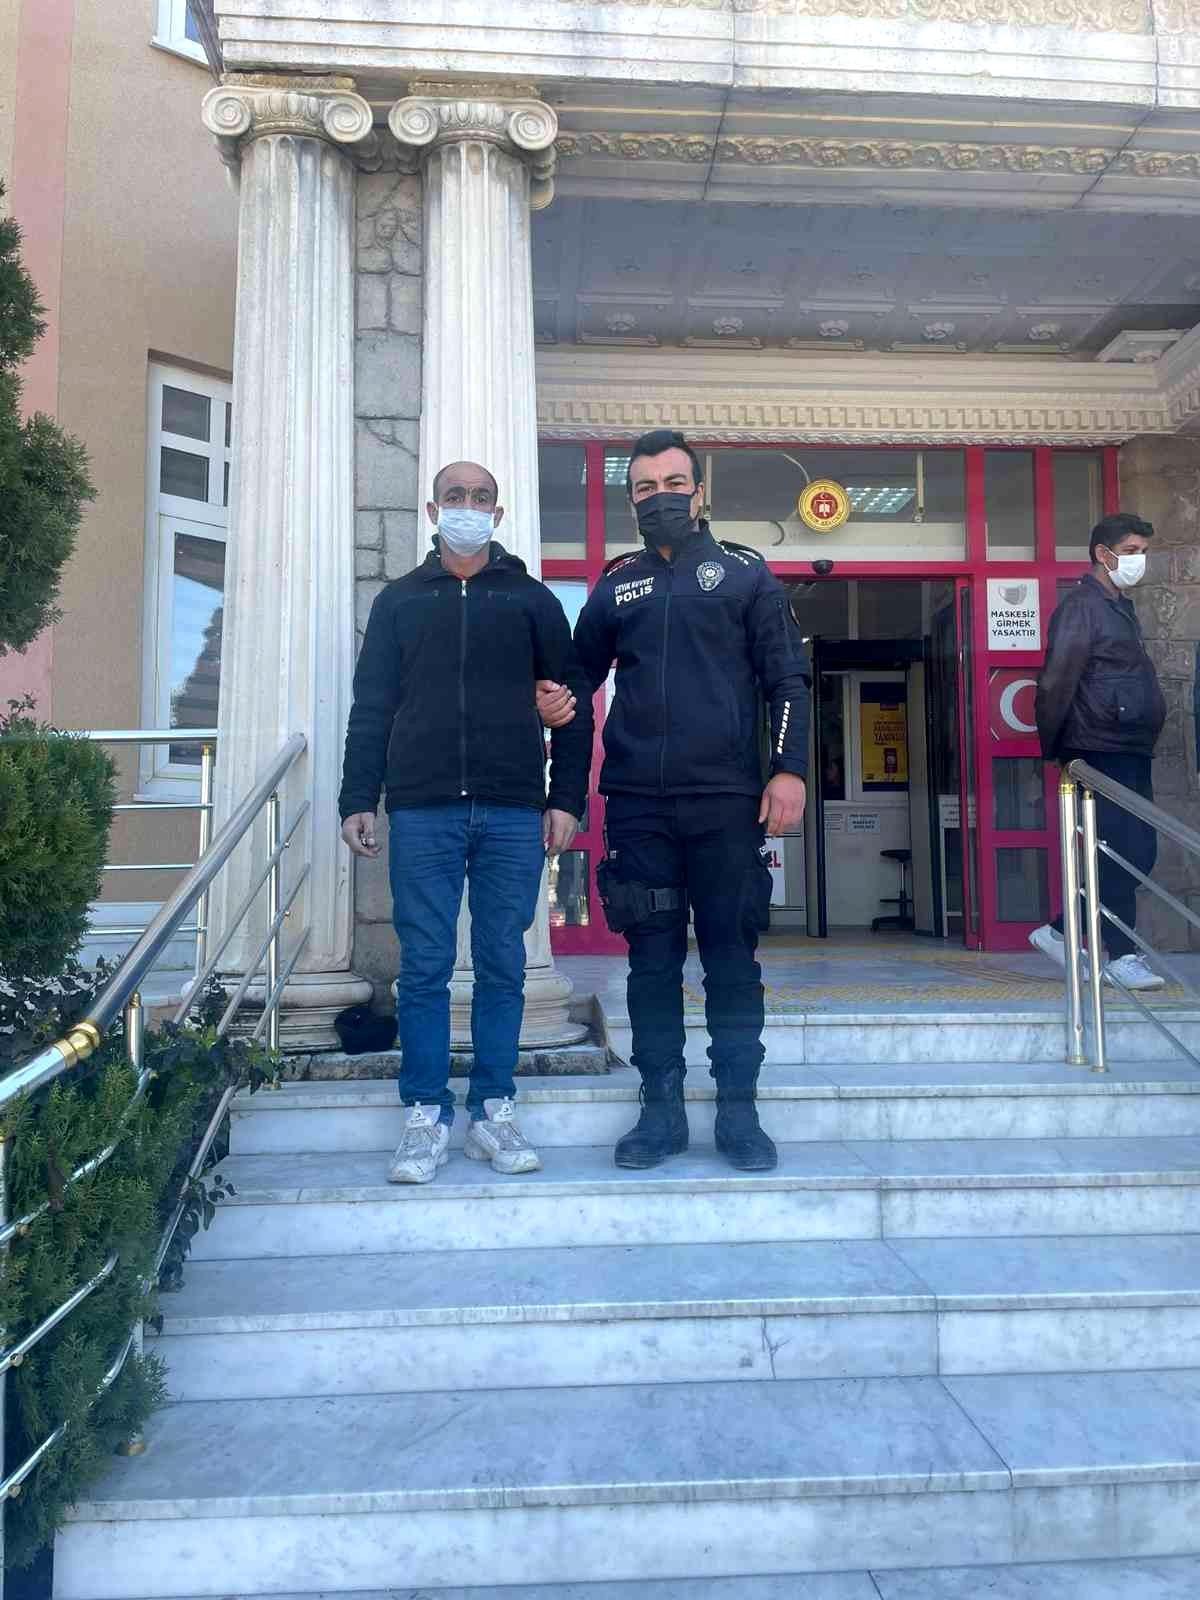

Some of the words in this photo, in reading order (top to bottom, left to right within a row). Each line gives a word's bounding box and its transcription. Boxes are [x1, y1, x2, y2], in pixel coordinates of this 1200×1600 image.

[991, 609, 1036, 618] MASKESİZ
[996, 619, 1031, 627] GİRMEK
[991, 629, 1036, 637] YASAKTIR
